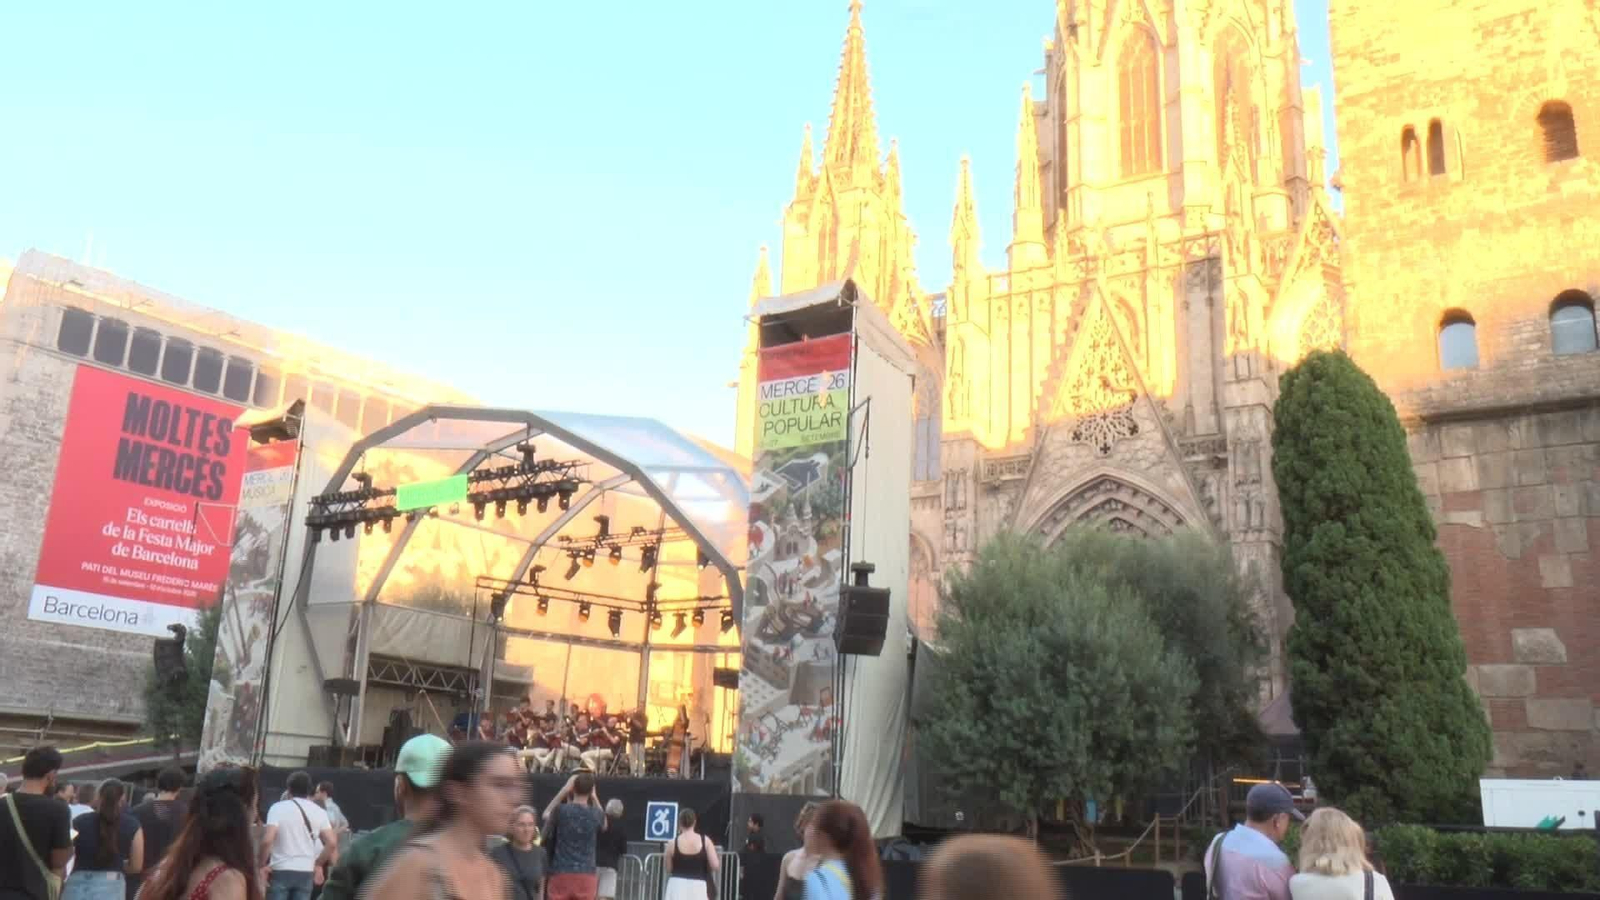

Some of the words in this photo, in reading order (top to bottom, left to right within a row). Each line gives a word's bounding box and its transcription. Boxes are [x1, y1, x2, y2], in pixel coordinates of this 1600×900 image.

[827, 373, 845, 390] 26
[759, 393, 835, 418] CULTURA
[121, 391, 233, 457] MOLTES
[763, 412, 842, 437] POPULAR
[113, 436, 226, 501] MERCÈS
[126, 507, 148, 526] Els
[149, 514, 197, 534] cartells
[102, 520, 120, 537] de
[123, 524, 136, 540] la
[138, 528, 173, 548] Festa
[175, 535, 215, 556] Major
[111, 542, 130, 558] de
[131, 544, 198, 570] Barcelona
[81, 561, 101, 573] PATI
[102, 565, 117, 576] DEL
[120, 568, 150, 581] MUSEU
[43, 595, 139, 625] Barcelona
